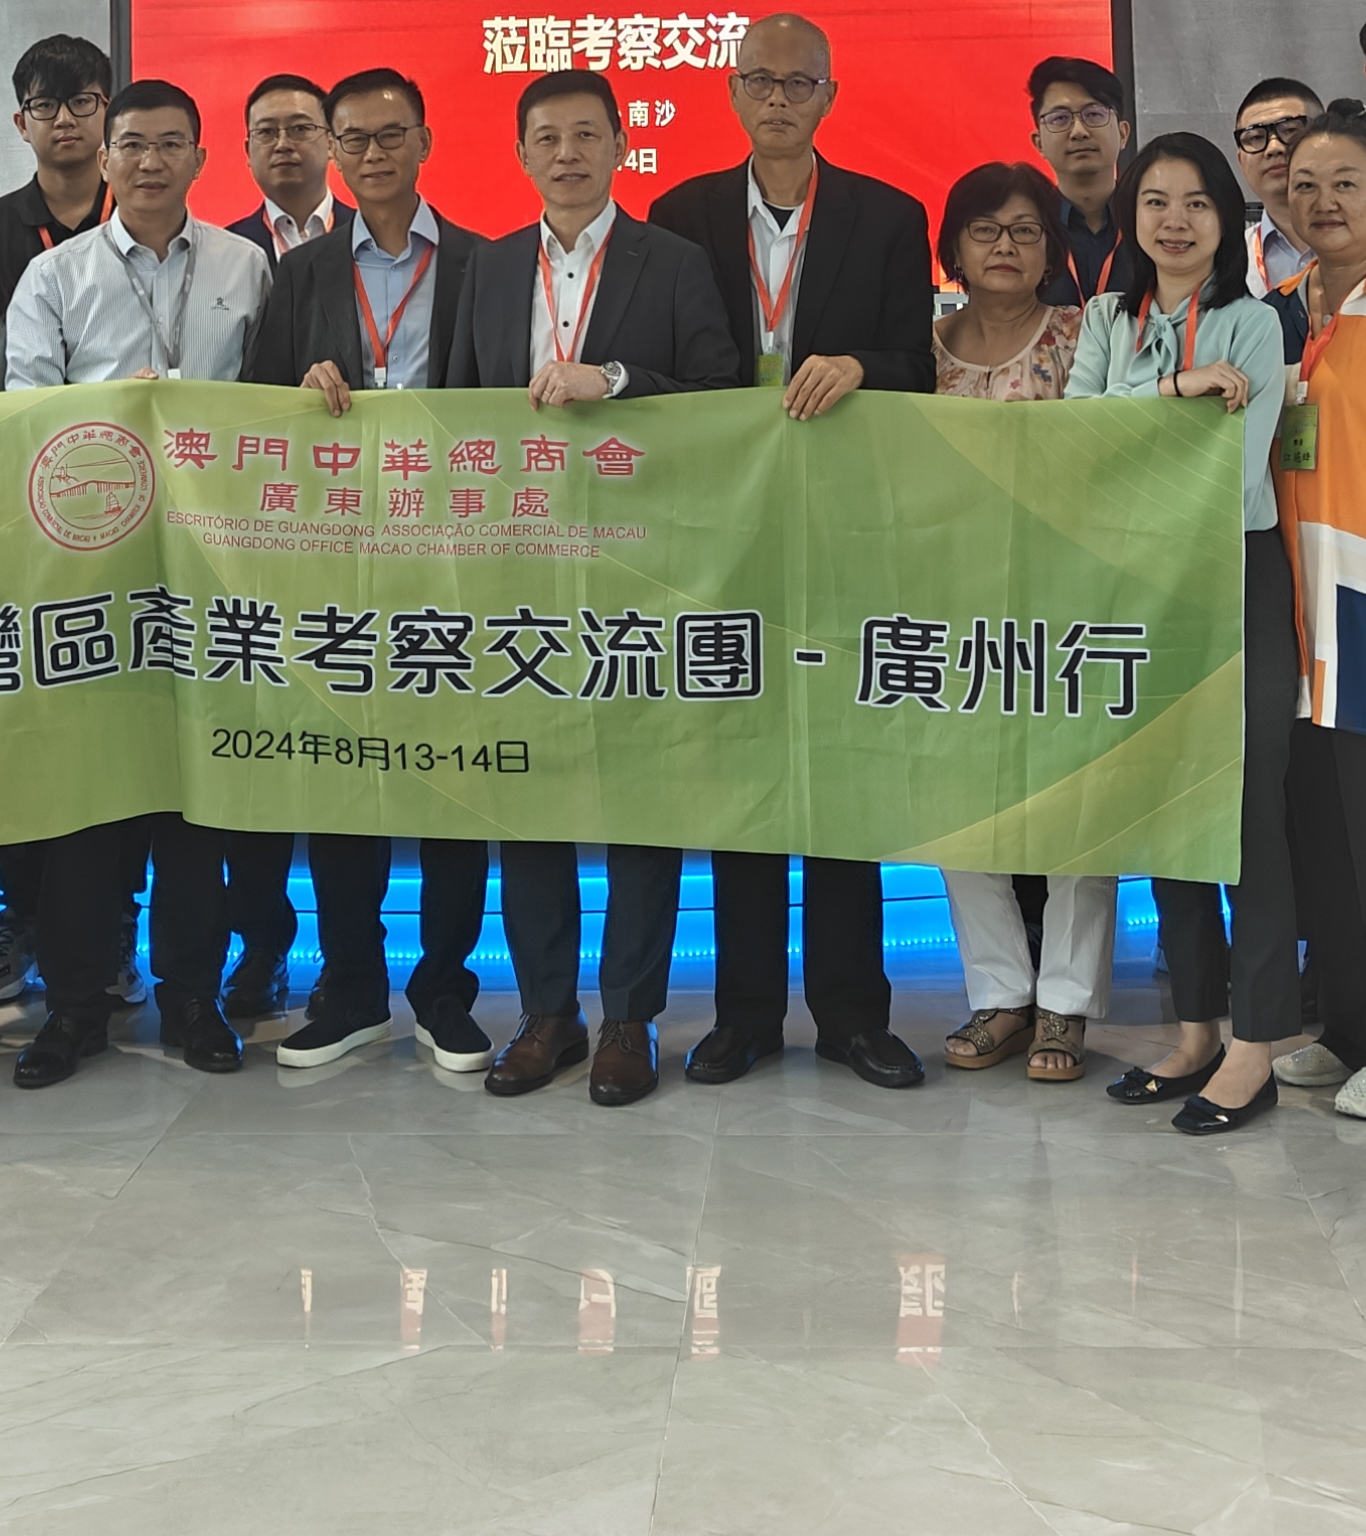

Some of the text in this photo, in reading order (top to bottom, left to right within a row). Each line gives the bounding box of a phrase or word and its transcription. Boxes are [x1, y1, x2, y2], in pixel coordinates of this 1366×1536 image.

[617, 148, 657, 174] 4日
[164, 428, 645, 481] 澳門中華總商會
[260, 482, 549, 519] 廣東辦事處
[166, 511, 647, 540] ESCRITÓRIO DE GUANGDONG ASSOCIAÇÃO COMERCIAL DE MACAU
[203, 532, 600, 557] GUANGDONG OFFICE MACAO CHAMBER OF COMMERCE
[856, 615, 1148, 717] 廣州行
[211, 728, 530, 773] 2024年8月13-14日
